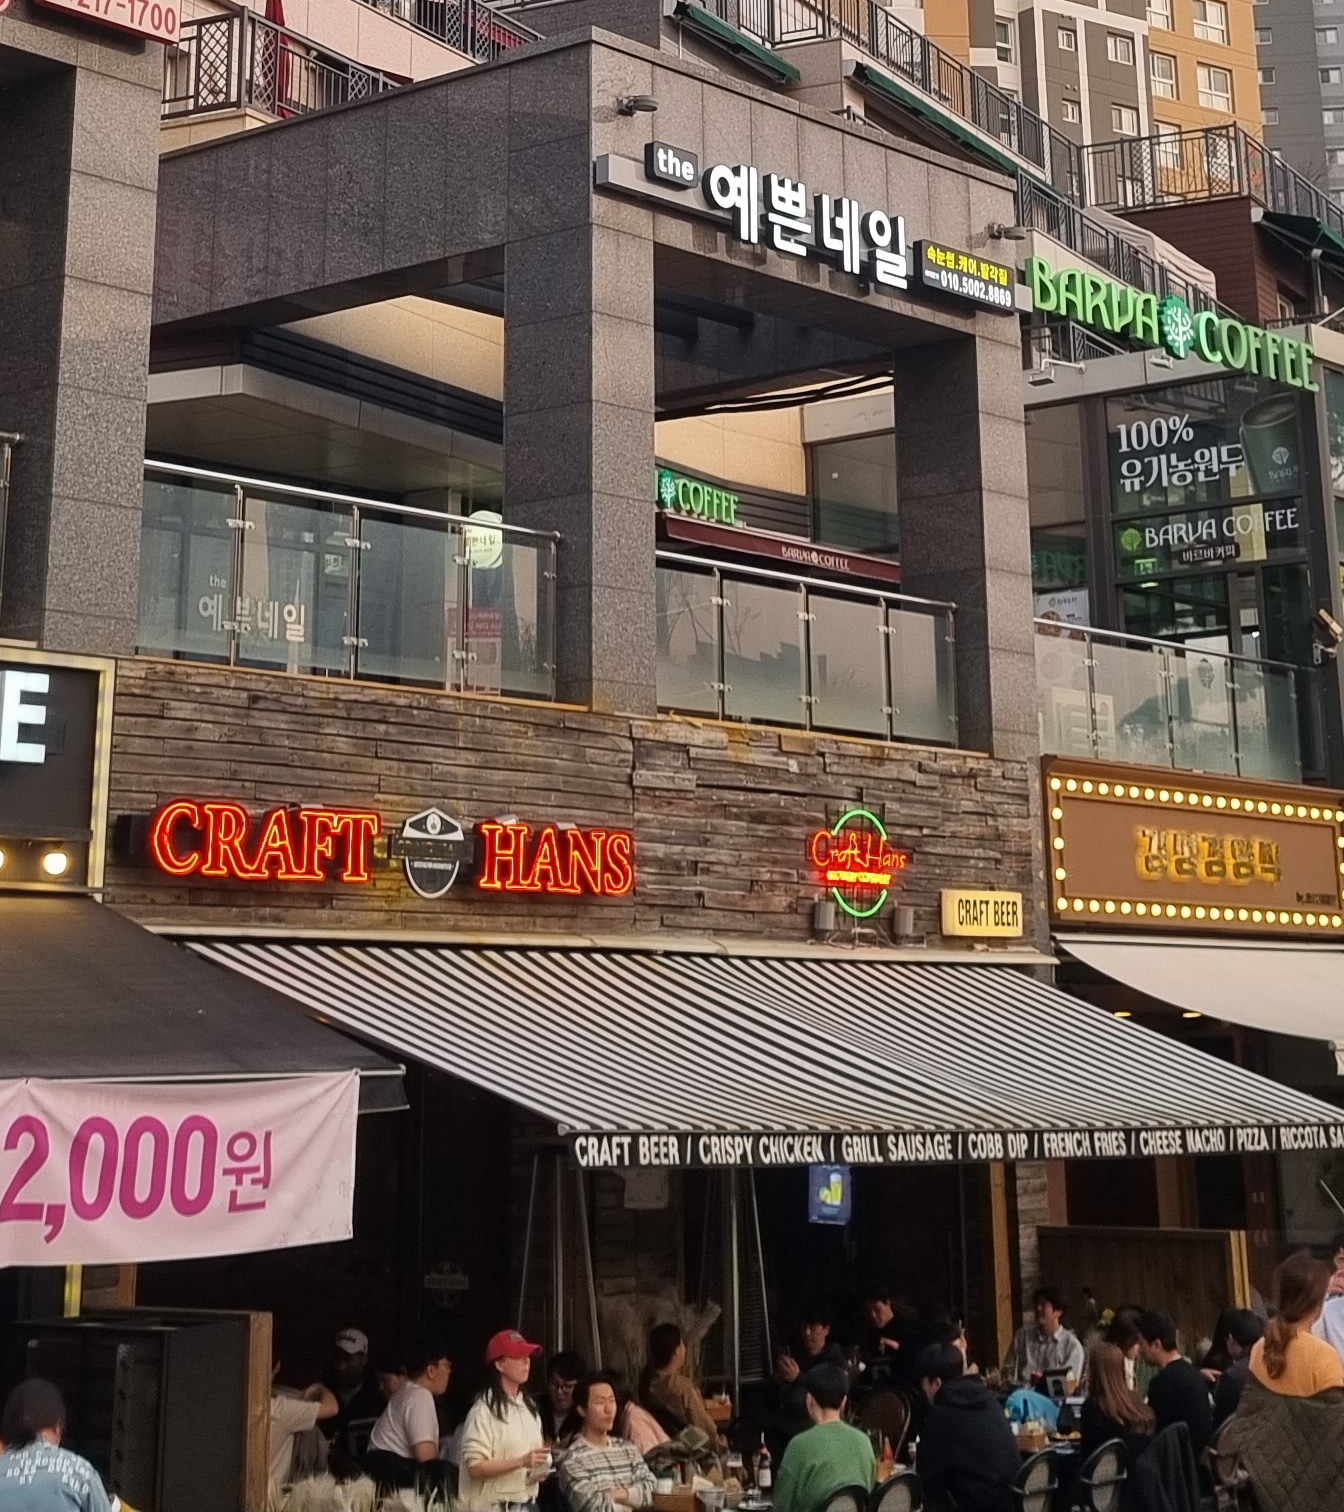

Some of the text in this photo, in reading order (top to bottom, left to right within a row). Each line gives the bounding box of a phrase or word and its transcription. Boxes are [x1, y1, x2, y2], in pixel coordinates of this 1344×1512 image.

[657, 148, 907, 289] the 예쁜네일
[1026, 255, 1320, 391] BARVA COFFEE
[1117, 414, 1194, 452] 100%
[1120, 444, 1246, 492] 유기농원두
[678, 478, 739, 524] COFFEE
[1145, 508, 1299, 548] BARVA COFEE
[209, 575, 227, 589] the
[819, 554, 850, 571] COFFEE
[153, 802, 633, 896] CRAFT HANS
[958, 899, 1019, 927] CRAFT BEER
[575, 1136, 631, 1167] CRAFT
[639, 1136, 680, 1166] BEER
[699, 1136, 754, 1164] CRISPY
[759, 1135, 824, 1164] CHICKEN
[842, 1135, 883, 1163] GRILL
[888, 1133, 953, 1162] SAUSAGE
[968, 1132, 1003, 1159] COBB
[1007, 1133, 1029, 1158] DIP
[1043, 1131, 1092, 1157] FRENCH
[1095, 1131, 1127, 1156] FRIES
[1140, 1130, 1183, 1155] CHEESE
[1187, 1129, 1226, 1154] NACHO
[1237, 1128, 1269, 1151] PIZZA
[1279, 1126, 1328, 1150] RICCOTA
